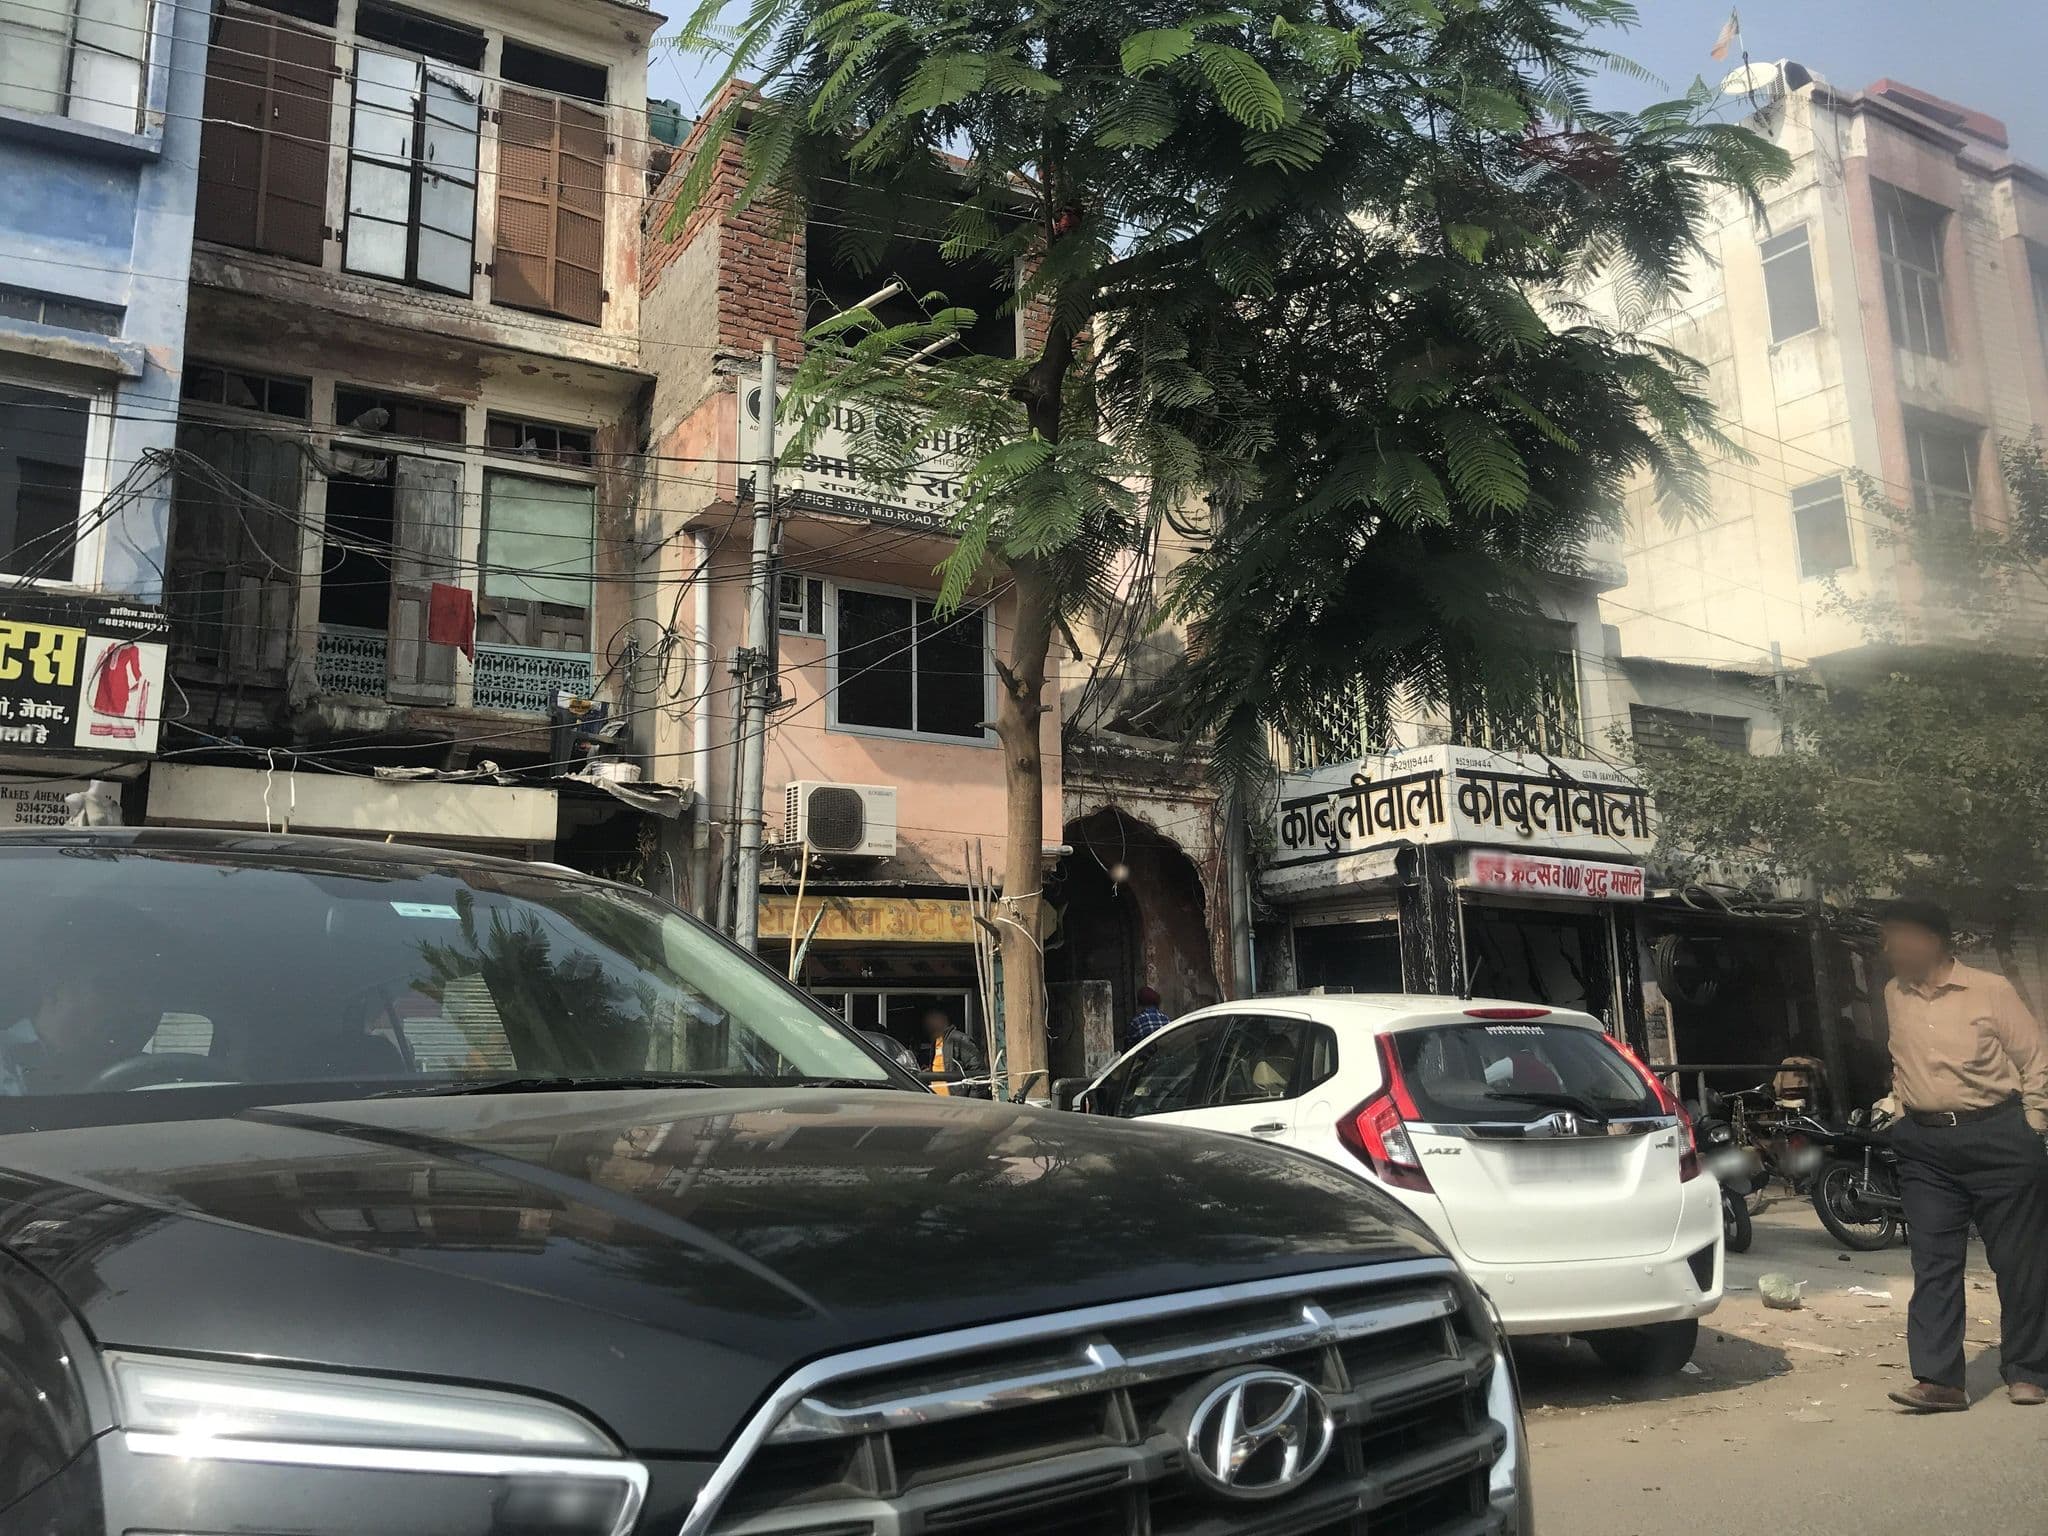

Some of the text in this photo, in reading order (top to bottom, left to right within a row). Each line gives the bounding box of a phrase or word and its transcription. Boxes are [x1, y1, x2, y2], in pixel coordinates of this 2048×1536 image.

[33, 790, 72, 803] AHEMA
[1456, 762, 1649, 840] काबुलीवाला
[16, 802, 70, 815] 931475841
[1611, 868, 1643, 896] मसाले
[1423, 1147, 1463, 1155] JAZZ
